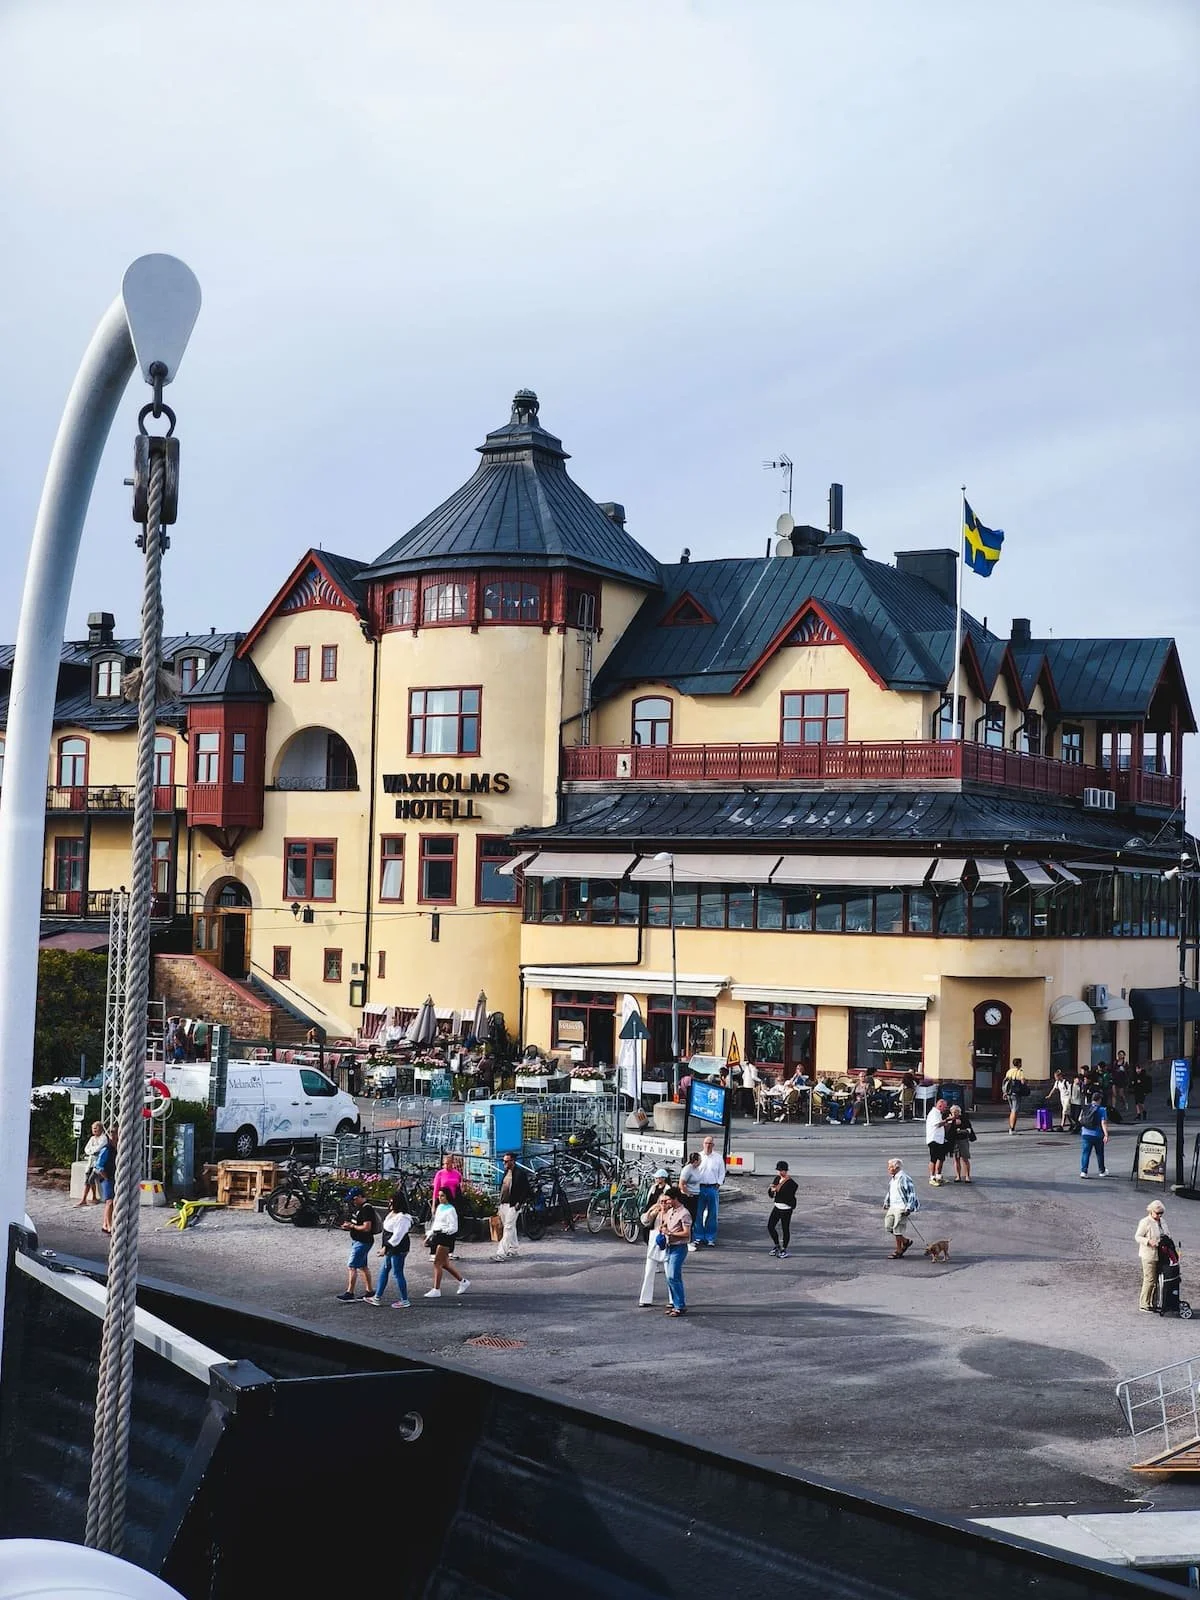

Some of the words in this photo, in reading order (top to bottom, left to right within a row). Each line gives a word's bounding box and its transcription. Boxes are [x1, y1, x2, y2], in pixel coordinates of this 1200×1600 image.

[382, 772, 510, 793] WAXHOLMS
[395, 799, 482, 819] HOTELL
[624, 1143, 648, 1151] RENT
[658, 1147, 681, 1157] BIKE
